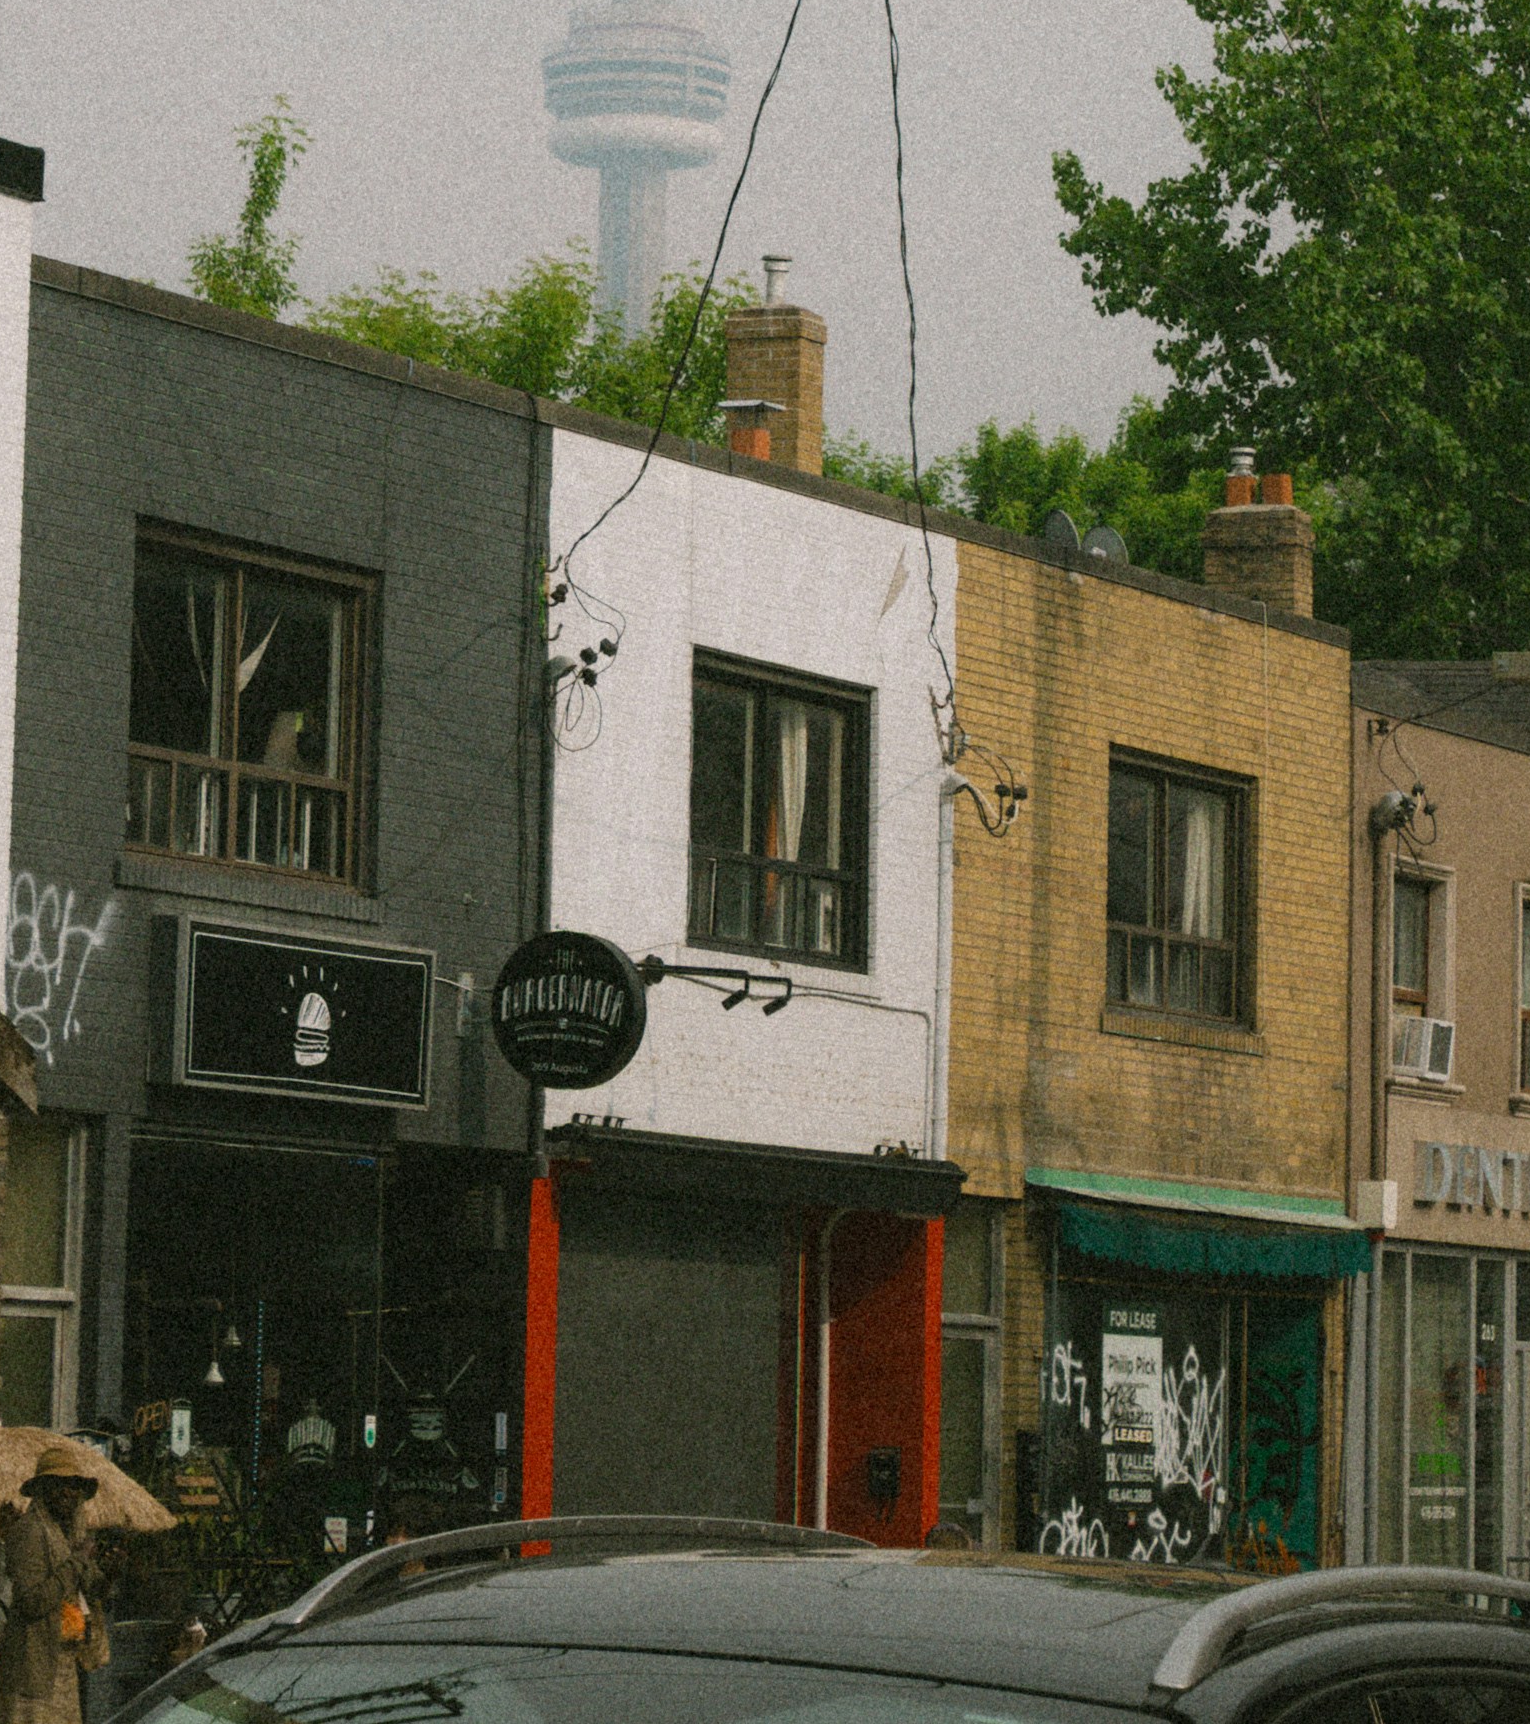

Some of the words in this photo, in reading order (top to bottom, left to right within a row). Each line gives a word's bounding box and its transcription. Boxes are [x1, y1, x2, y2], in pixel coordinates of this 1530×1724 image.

[1110, 1310, 1128, 1328] FOR
[1129, 1311, 1158, 1331] LEASE
[1135, 1355, 1157, 1376] Pick
[1115, 1427, 1154, 1444] LEASED
